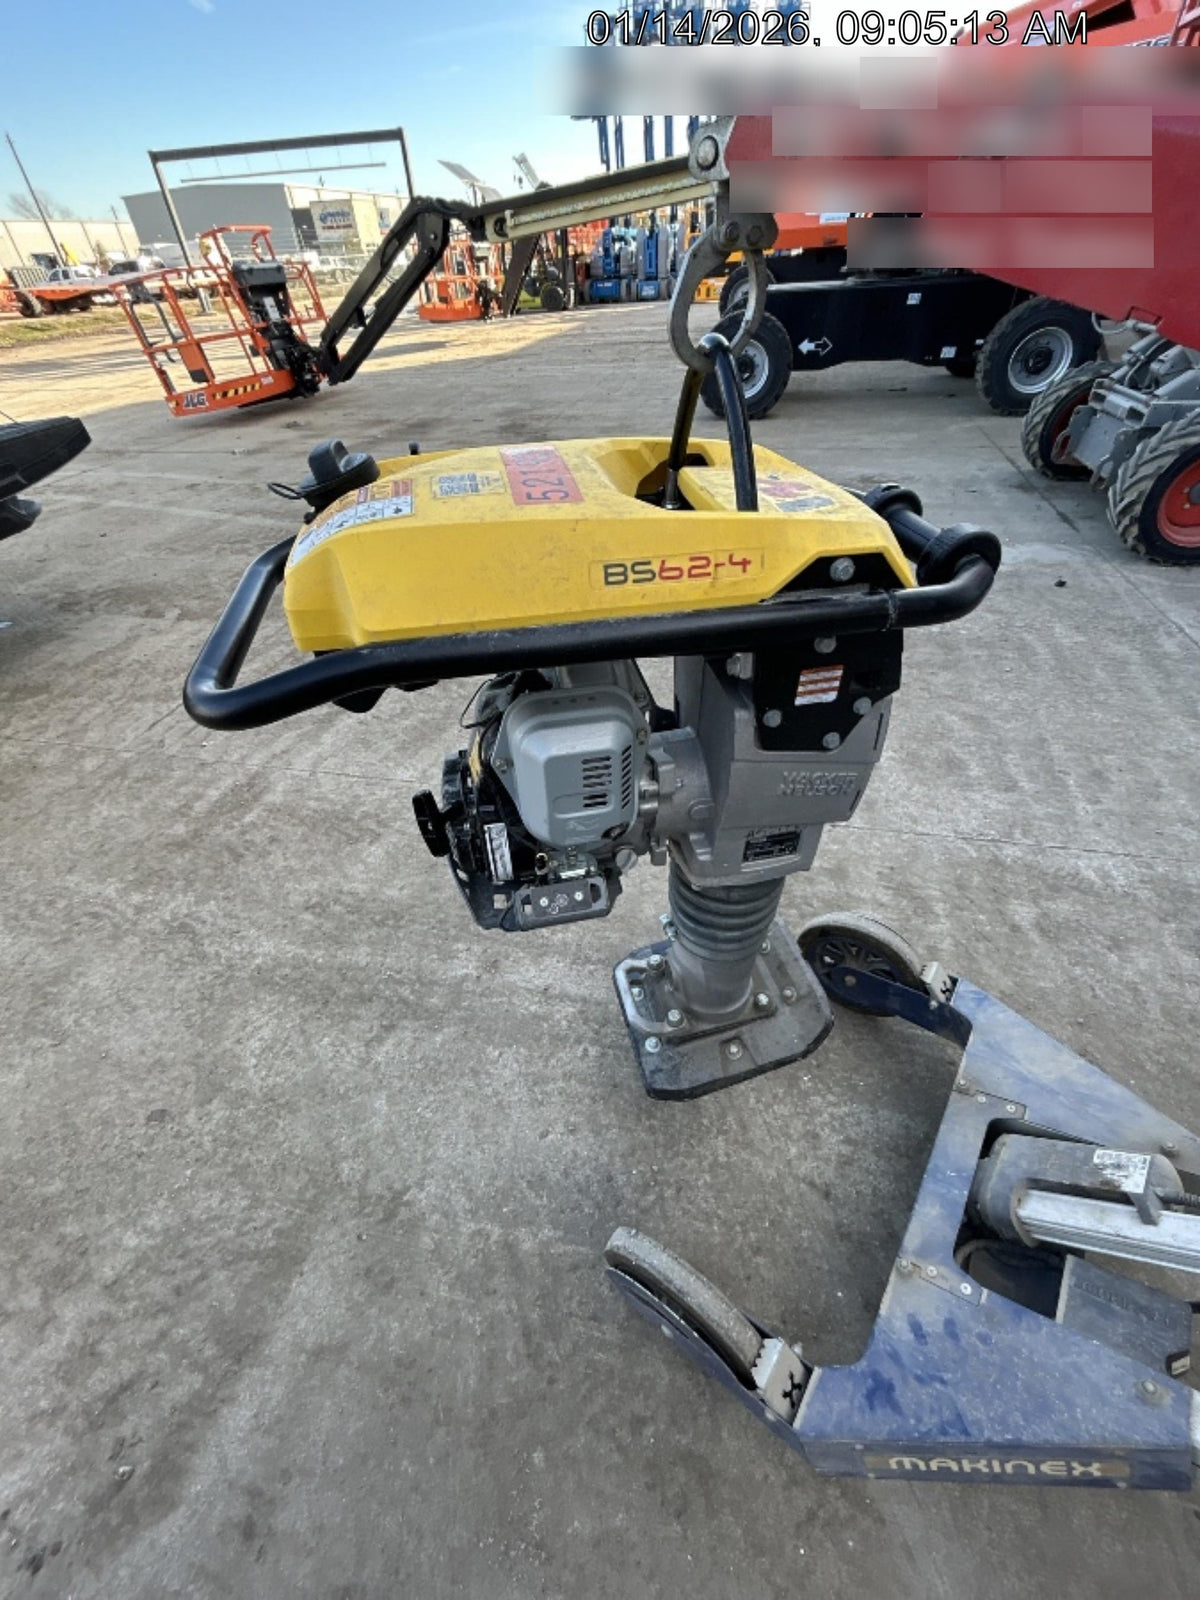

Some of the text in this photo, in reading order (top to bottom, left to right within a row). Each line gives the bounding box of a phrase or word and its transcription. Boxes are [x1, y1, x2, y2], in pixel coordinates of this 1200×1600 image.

[184, 391, 209, 408] JLG
[602, 553, 752, 586] BS62-4
[888, 1456, 1102, 1477] MAKINEX
